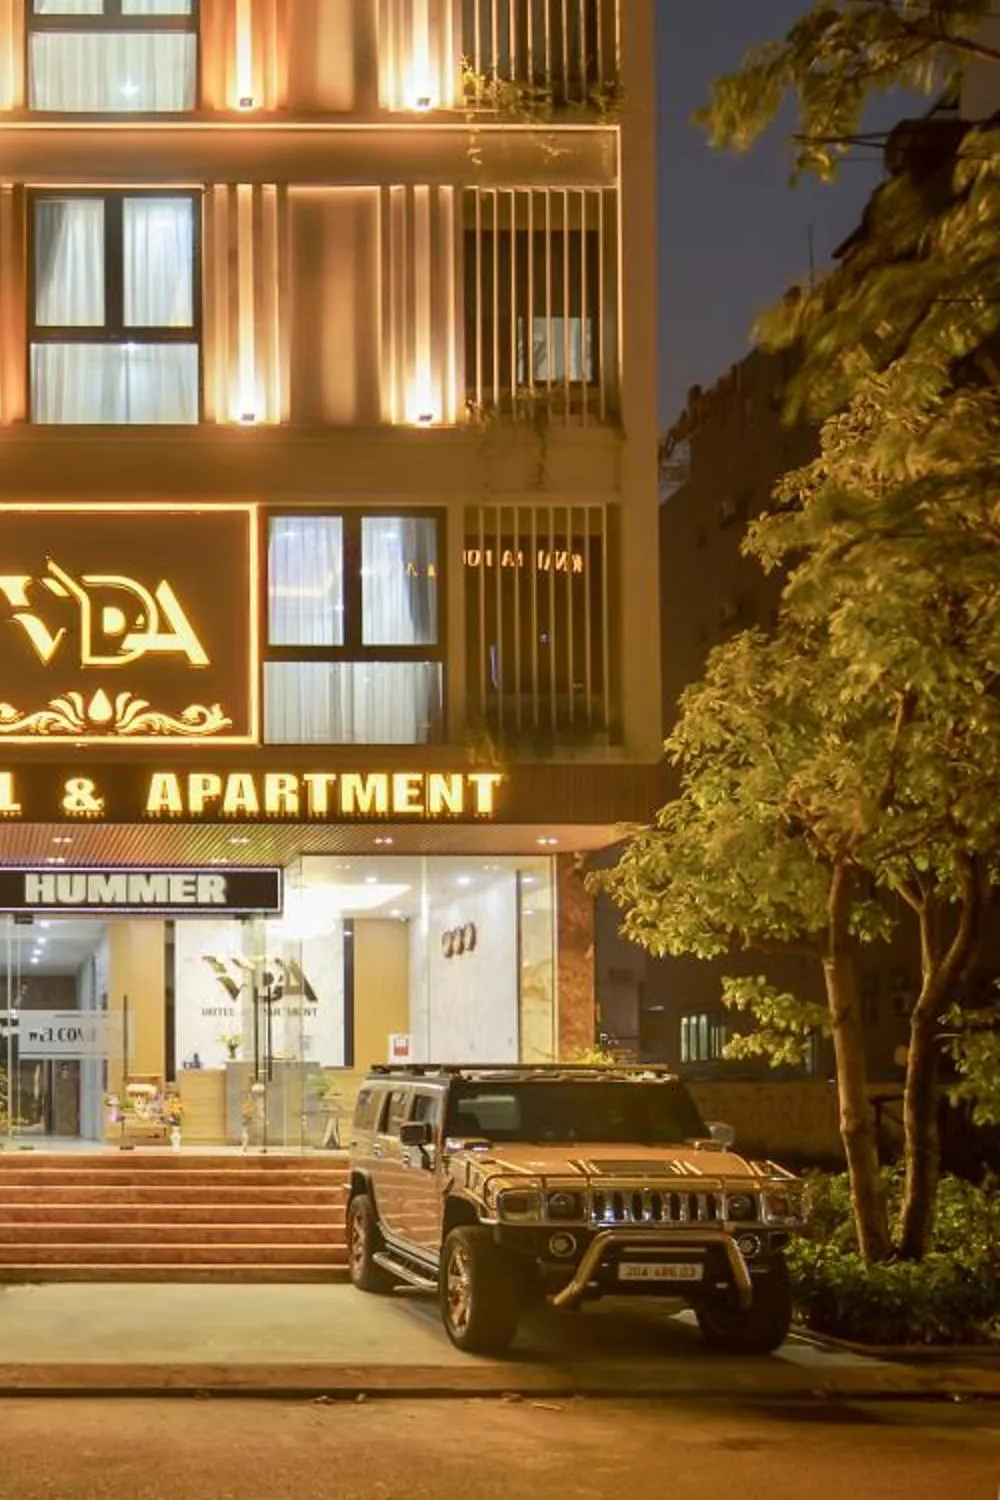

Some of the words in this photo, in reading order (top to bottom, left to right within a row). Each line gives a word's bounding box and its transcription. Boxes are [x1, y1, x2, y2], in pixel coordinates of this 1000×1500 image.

[62, 777, 104, 813] &
[147, 773, 503, 814] APARTMENT
[24, 873, 228, 904] HUMMER
